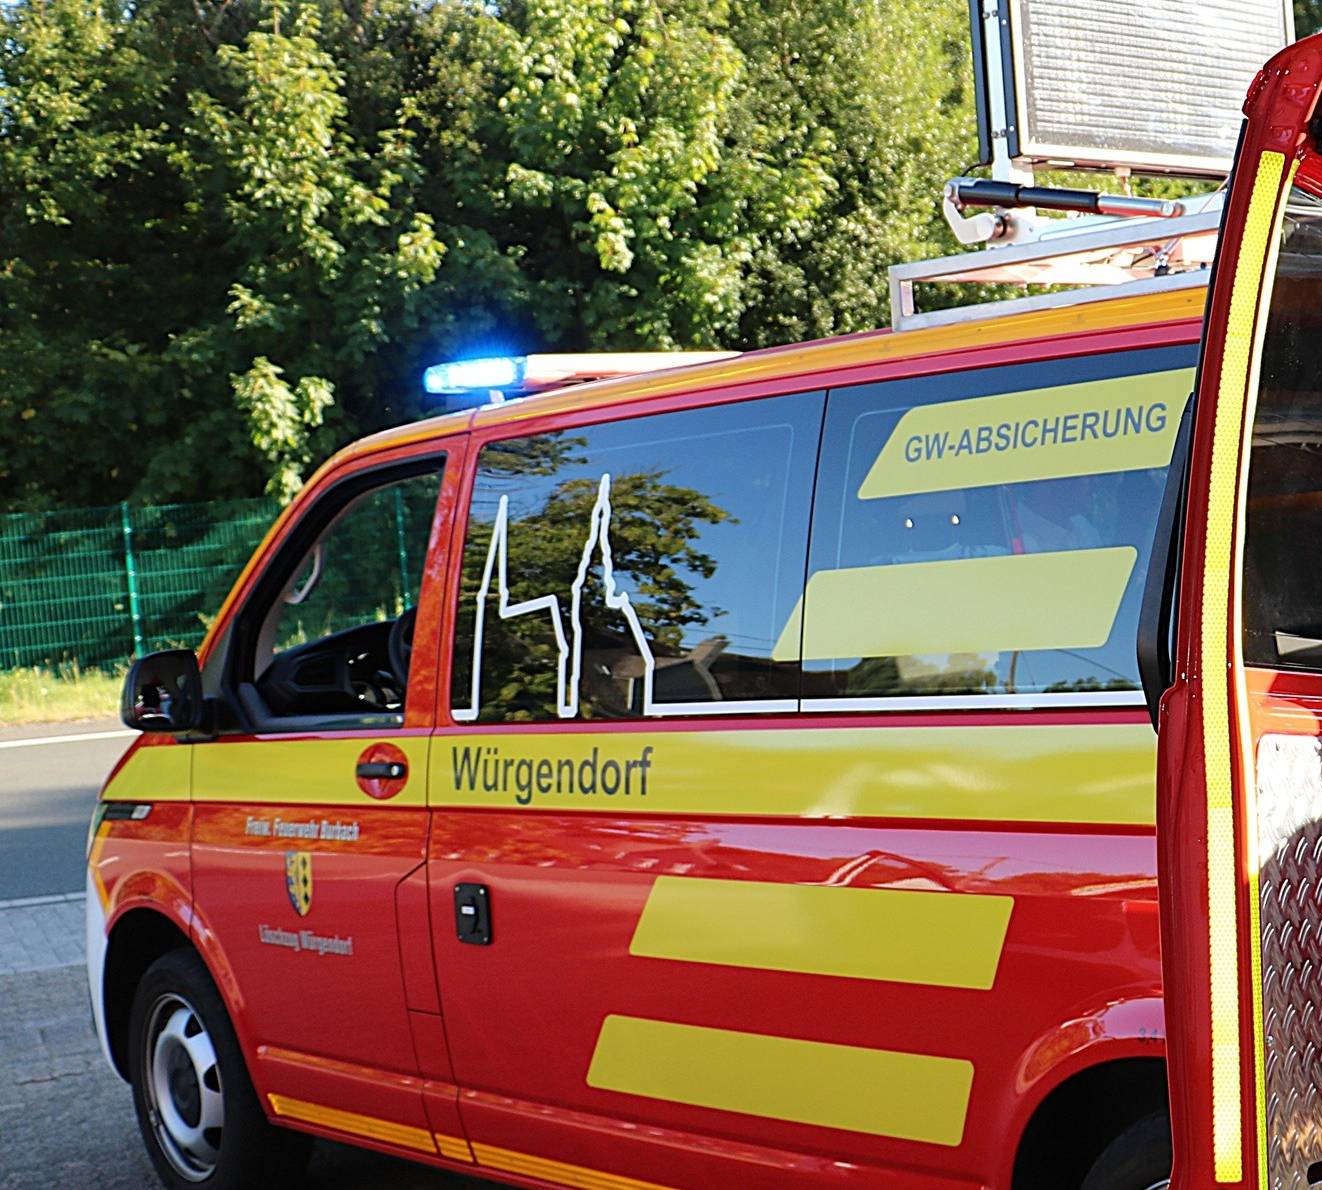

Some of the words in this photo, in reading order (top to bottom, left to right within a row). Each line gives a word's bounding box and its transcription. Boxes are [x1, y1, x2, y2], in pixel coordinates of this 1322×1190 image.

[905, 402, 1167, 463] GW-ABSICHERUNG
[452, 746, 654, 805] Würgendorf
[273, 818, 319, 840] Feuerwehr
[300, 931, 353, 956] Würgendorf
